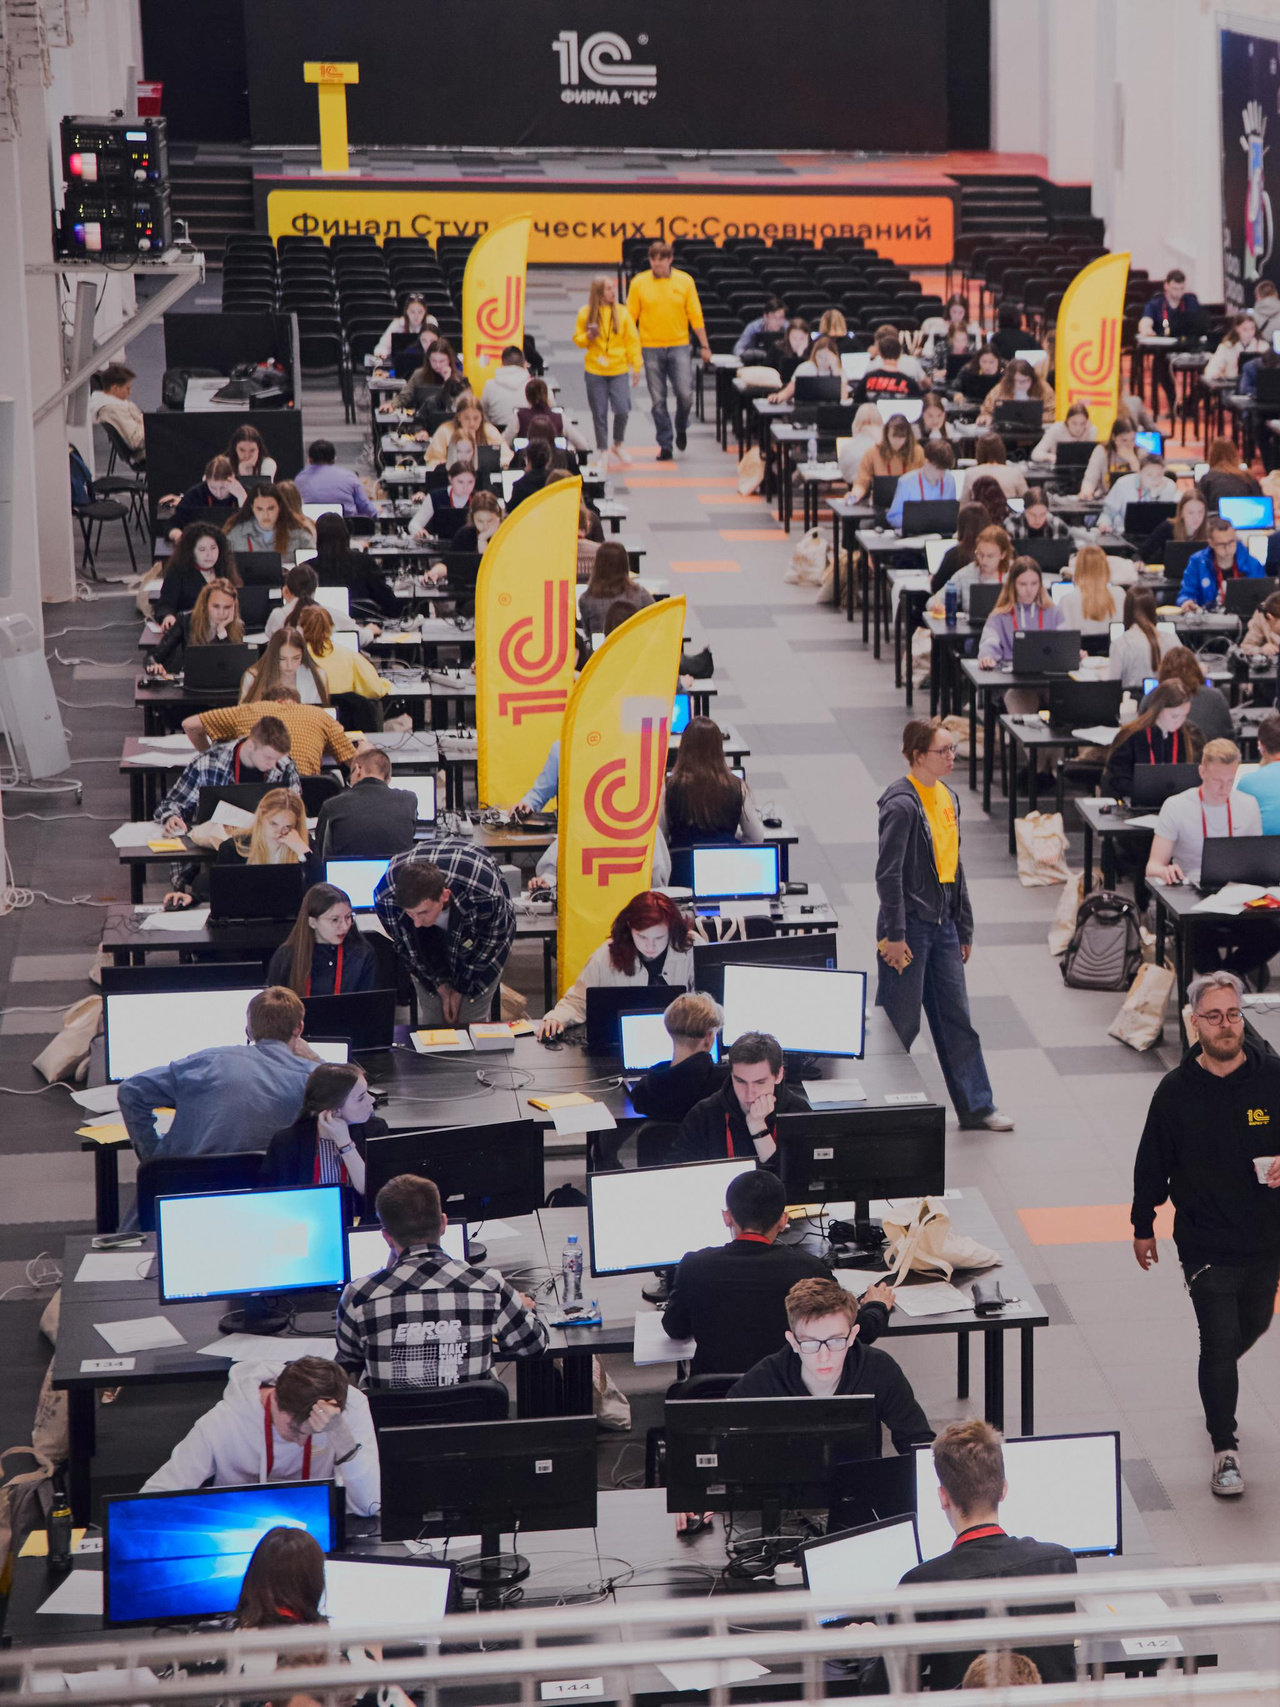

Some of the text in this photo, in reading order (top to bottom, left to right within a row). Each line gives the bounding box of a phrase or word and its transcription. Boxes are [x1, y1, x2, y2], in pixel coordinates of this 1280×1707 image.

[560, 89, 621, 104] ФИРМА
[290, 212, 932, 241] Финал Студческих 1С:Соревнований
[395, 1320, 462, 1338] ERROR
[439, 1343, 468, 1354] MAKE
[438, 1376, 460, 1387] LIFE
[1135, 1640, 1168, 1648] 142
[556, 1683, 591, 1692] 144
